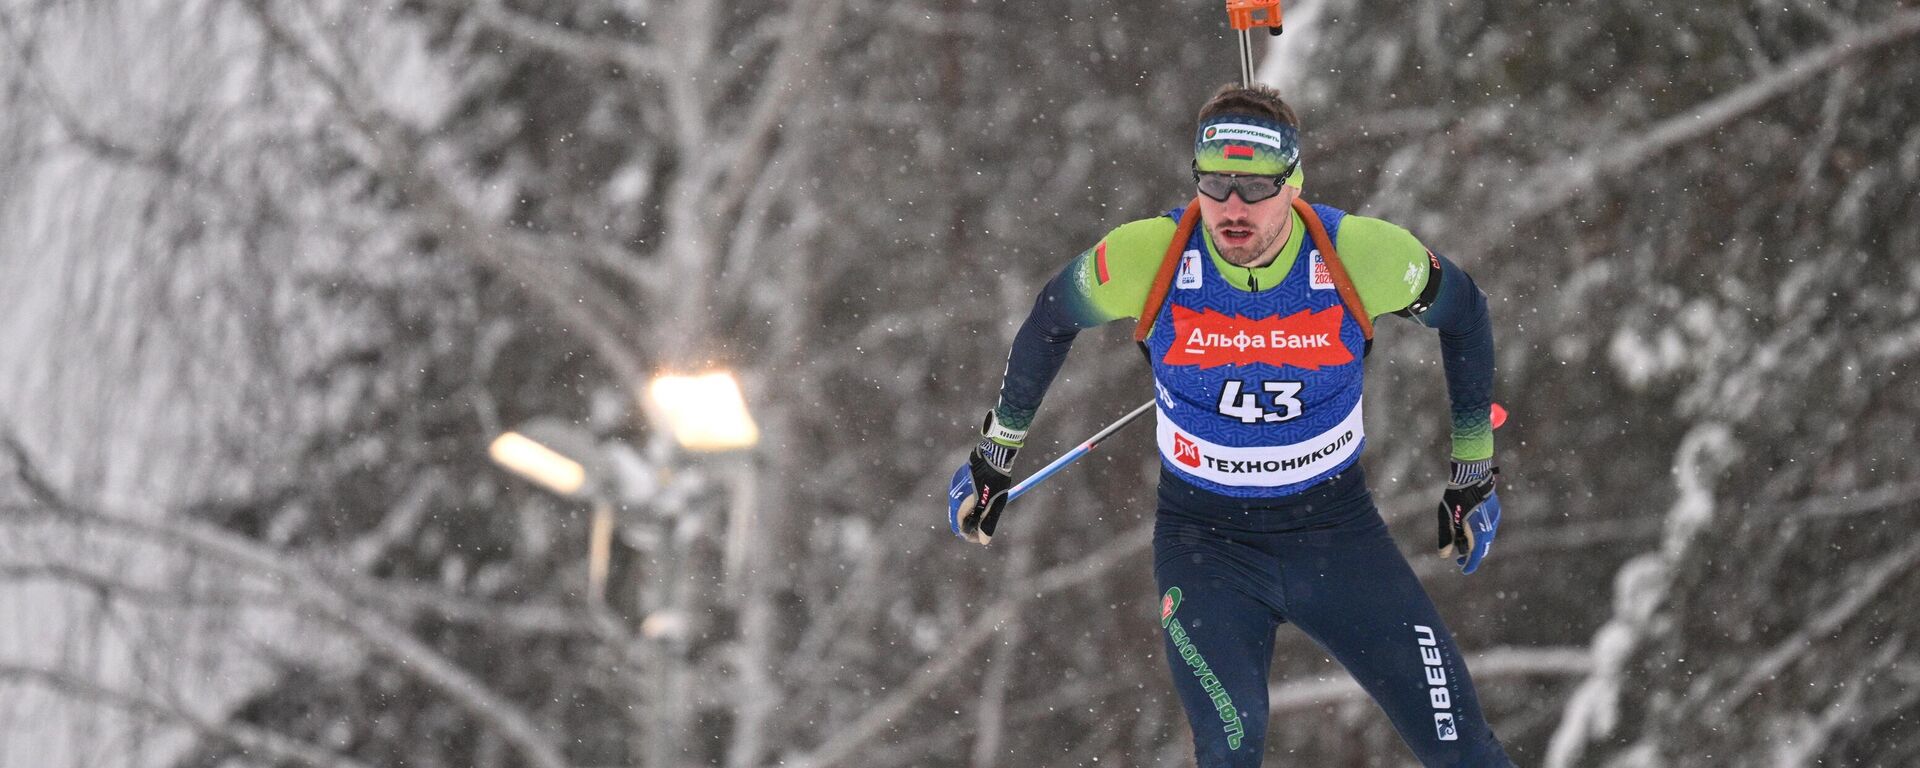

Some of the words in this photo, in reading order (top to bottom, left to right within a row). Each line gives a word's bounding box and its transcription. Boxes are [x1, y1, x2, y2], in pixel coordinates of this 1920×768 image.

[1218, 128, 1280, 142] БЕЛОРУСНЕФТЬ
[1315, 263, 1328, 273] 202
[1186, 327, 1265, 352] Альфа
[1271, 330, 1331, 349] Банк
[1218, 380, 1303, 423] 43
[1203, 430, 1353, 473] ТЕХНОНИКОЛЬ
[1168, 618, 1245, 750] БЕЛОРУСНЕФТЬ
[1413, 625, 1451, 709] BEEU
